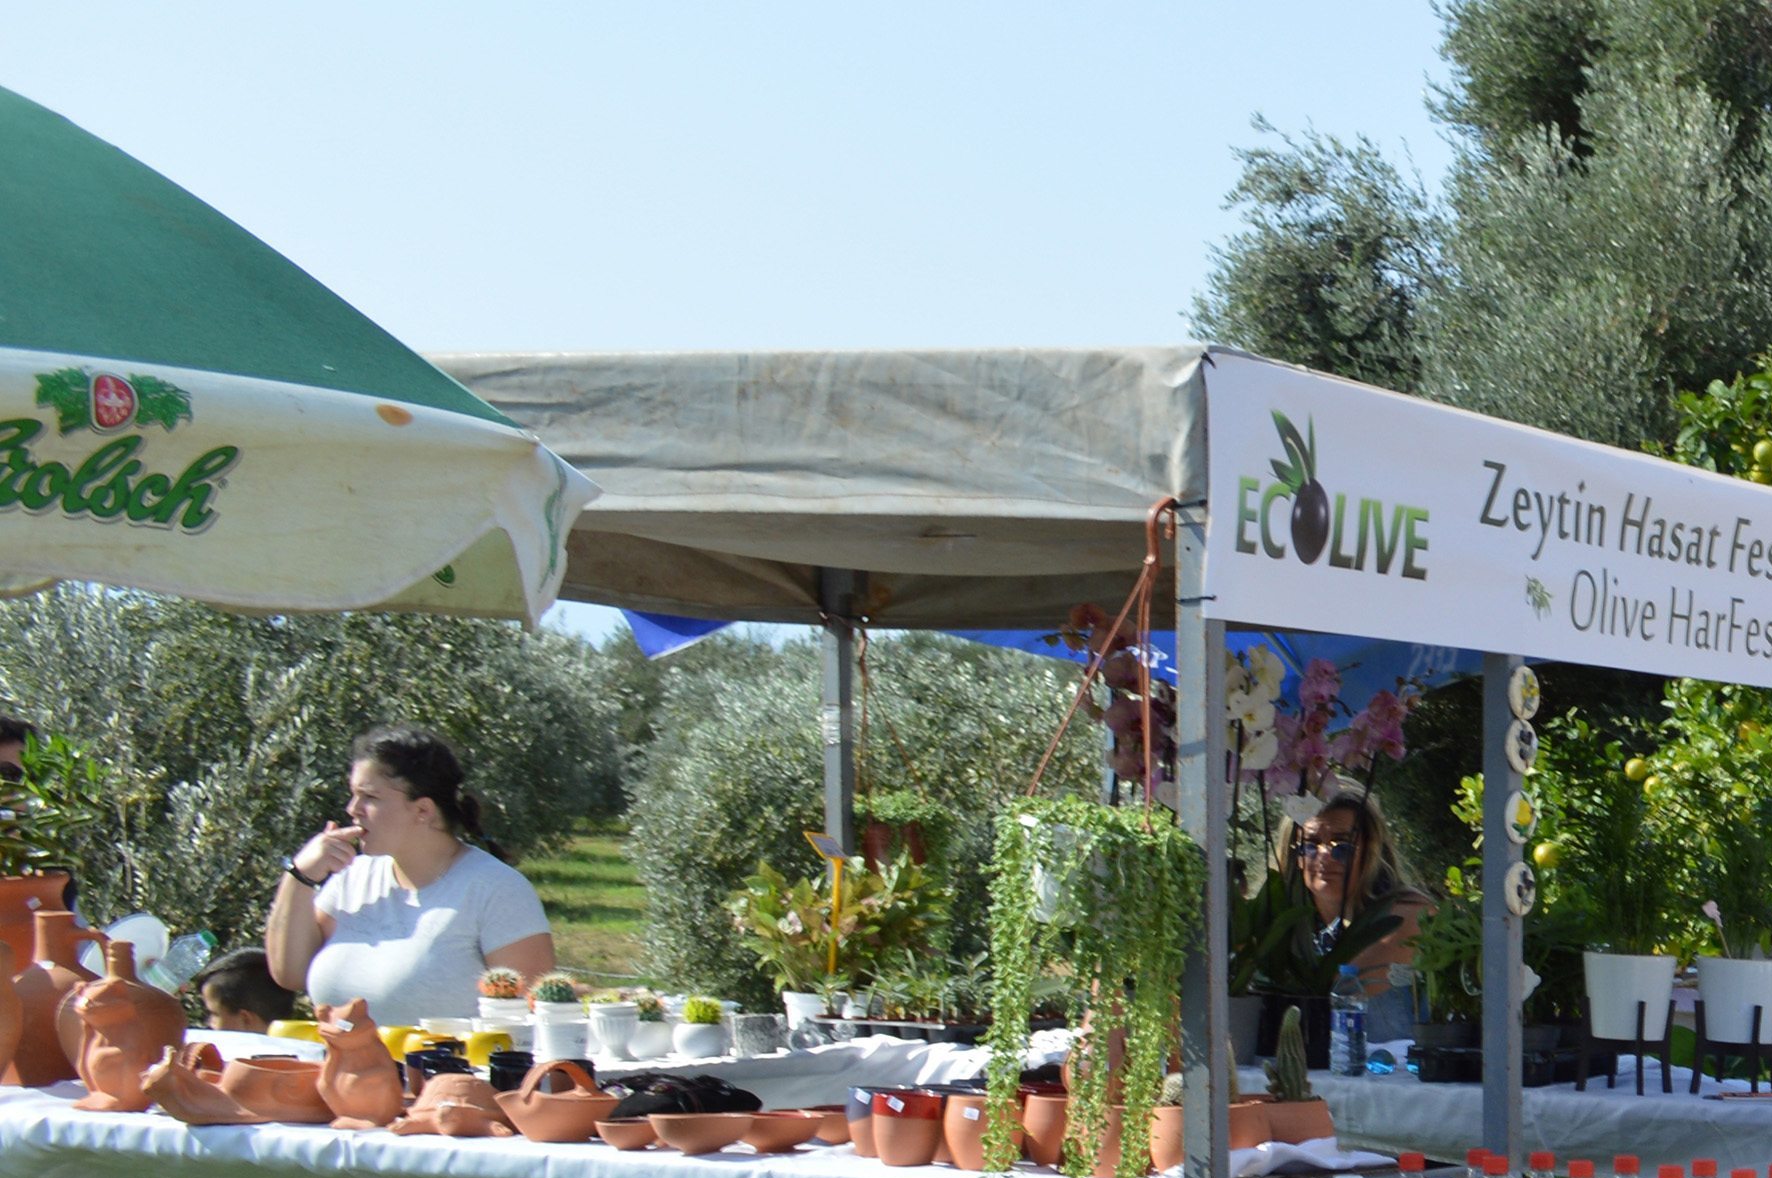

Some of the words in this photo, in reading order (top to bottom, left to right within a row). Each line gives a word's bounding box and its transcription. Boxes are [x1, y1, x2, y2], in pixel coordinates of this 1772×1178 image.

[1235, 474, 1430, 581] ECOLIVE
[1479, 459, 1607, 562] Zeytin
[1618, 492, 1721, 569] Hasat
[1570, 567, 1657, 641] Olive
